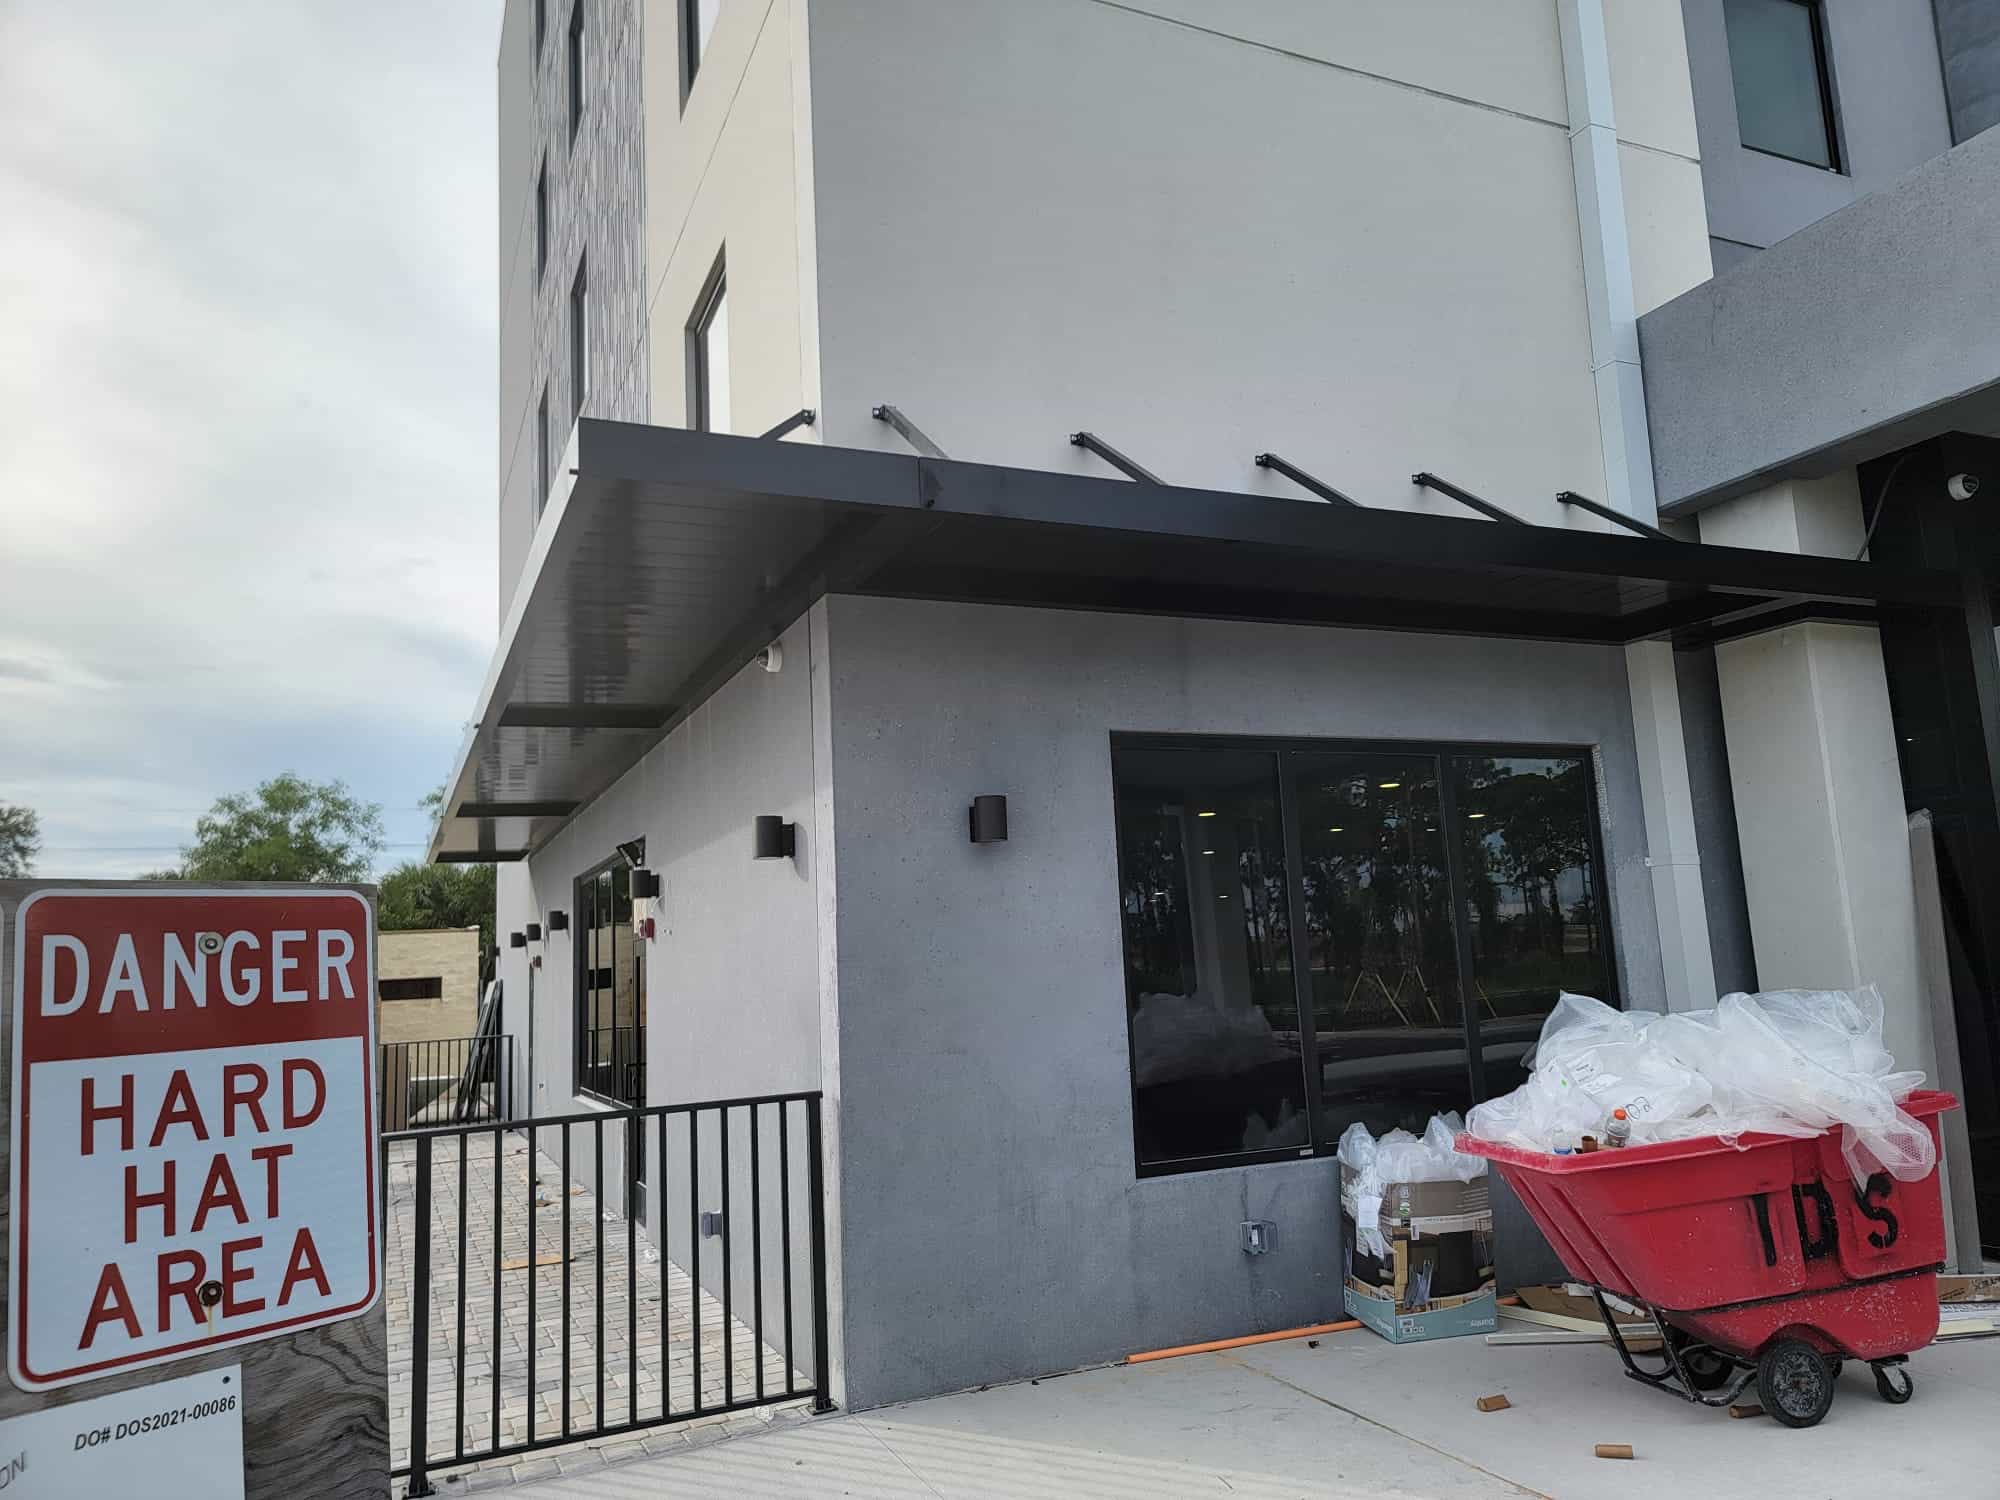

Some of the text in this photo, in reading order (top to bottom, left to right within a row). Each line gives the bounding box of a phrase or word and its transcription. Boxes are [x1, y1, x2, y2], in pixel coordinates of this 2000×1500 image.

[41, 929, 355, 1016] DANGER
[81, 1058, 326, 1155] HARD
[124, 1144, 293, 1243] HAT
[78, 1227, 332, 1350] AREA
[74, 1396, 236, 1450] DO# DOS2021-00086
